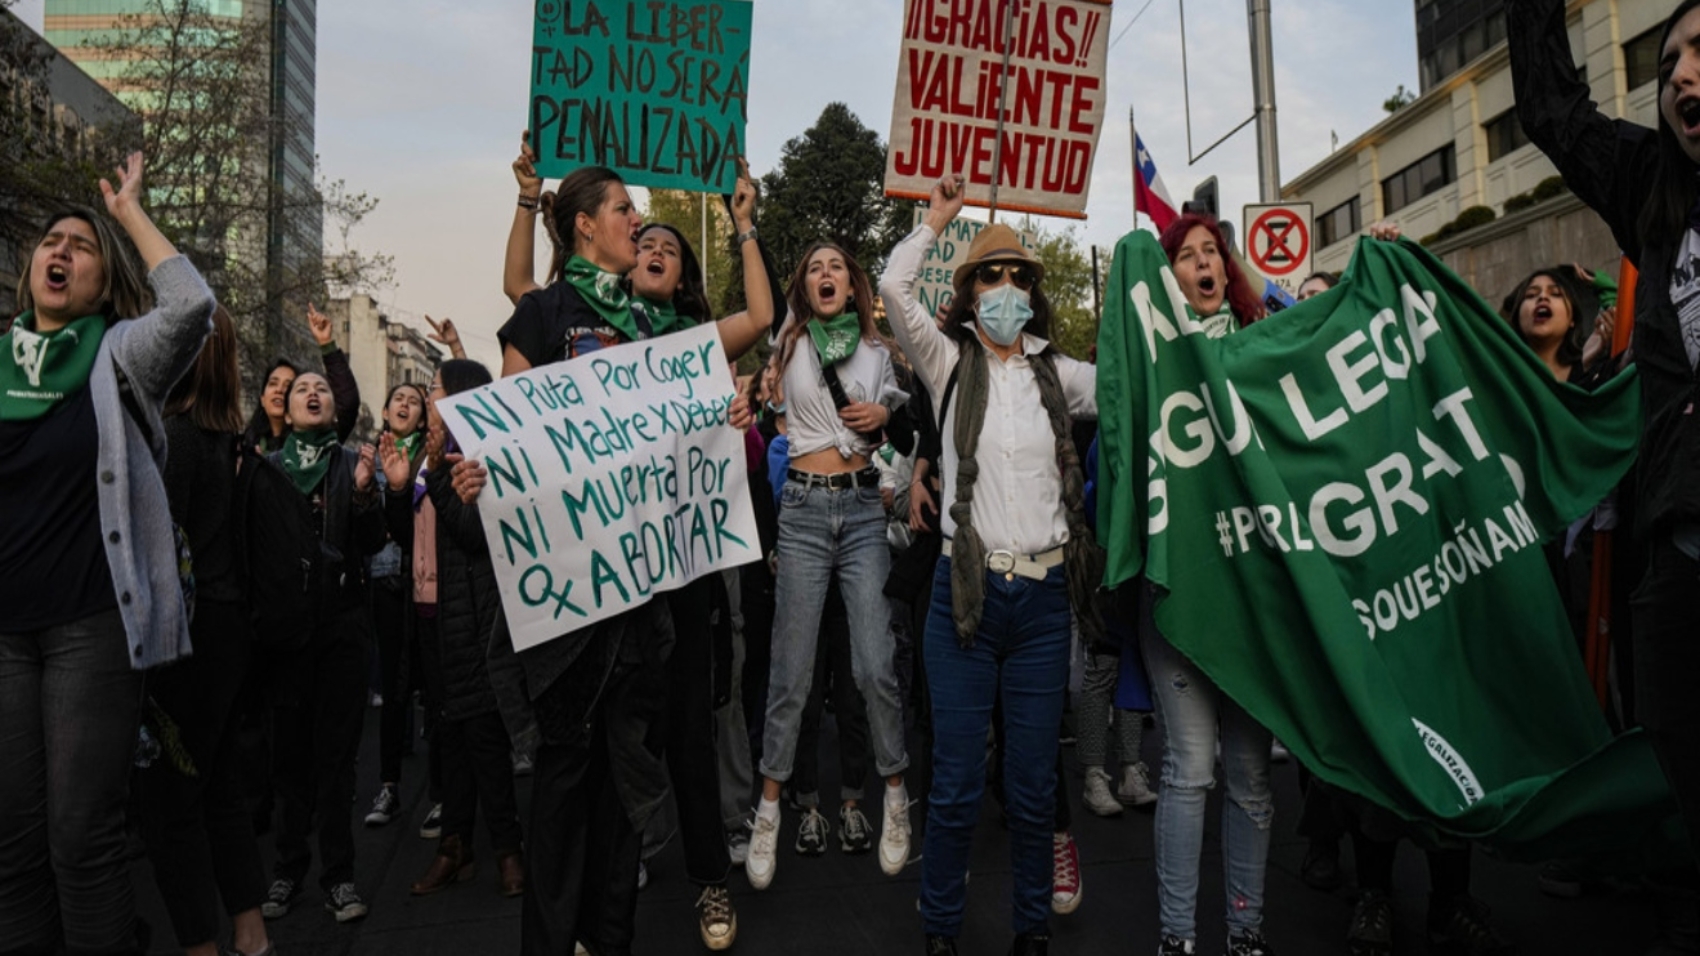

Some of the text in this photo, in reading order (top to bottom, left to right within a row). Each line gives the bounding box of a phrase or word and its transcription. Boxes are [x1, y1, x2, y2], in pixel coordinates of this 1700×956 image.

[563, 1, 610, 38] LA
[532, 44, 749, 124] TAD NO SERÁ
[532, 95, 743, 187] PENALIZADA
[895, 117, 1091, 194] JUVENTUD
[515, 374, 585, 416] Puta
[590, 358, 641, 398] Por
[644, 339, 716, 400] Coger
[544, 406, 658, 475] Madre
[687, 445, 732, 499] Por
